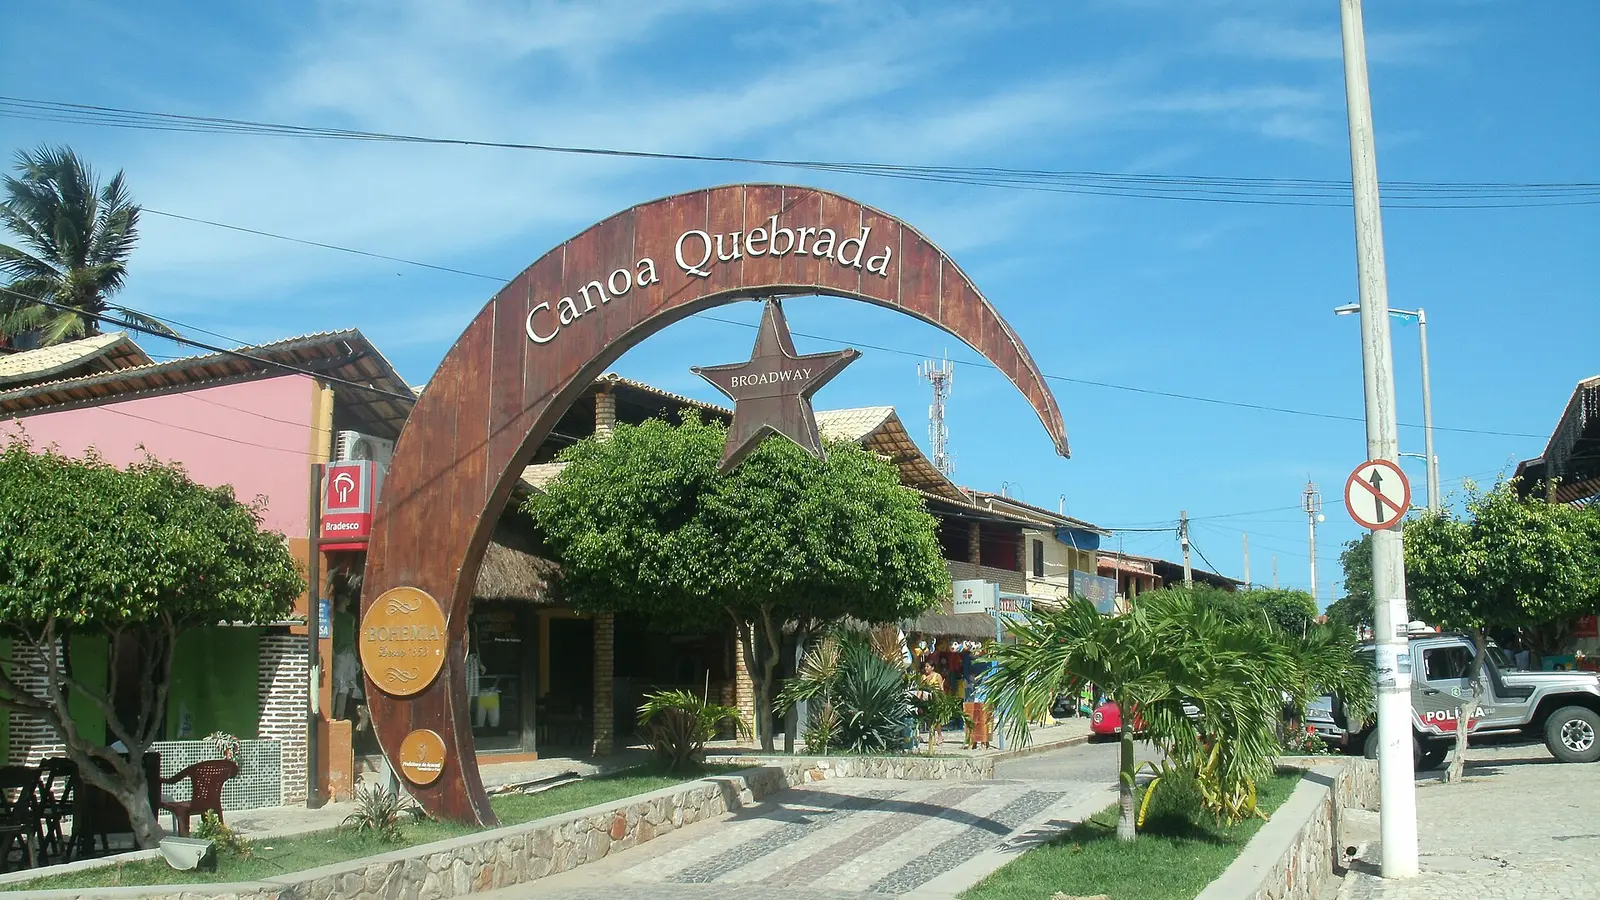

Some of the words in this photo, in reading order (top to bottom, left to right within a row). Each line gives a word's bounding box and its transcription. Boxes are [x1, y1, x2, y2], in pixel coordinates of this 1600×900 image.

[525, 257, 660, 344] Canoa
[731, 367, 812, 388] BROADWAY
[325, 521, 360, 531] Bradesco
[367, 625, 440, 642] BOHEMIA
[1426, 706, 1486, 722] POLÍA
